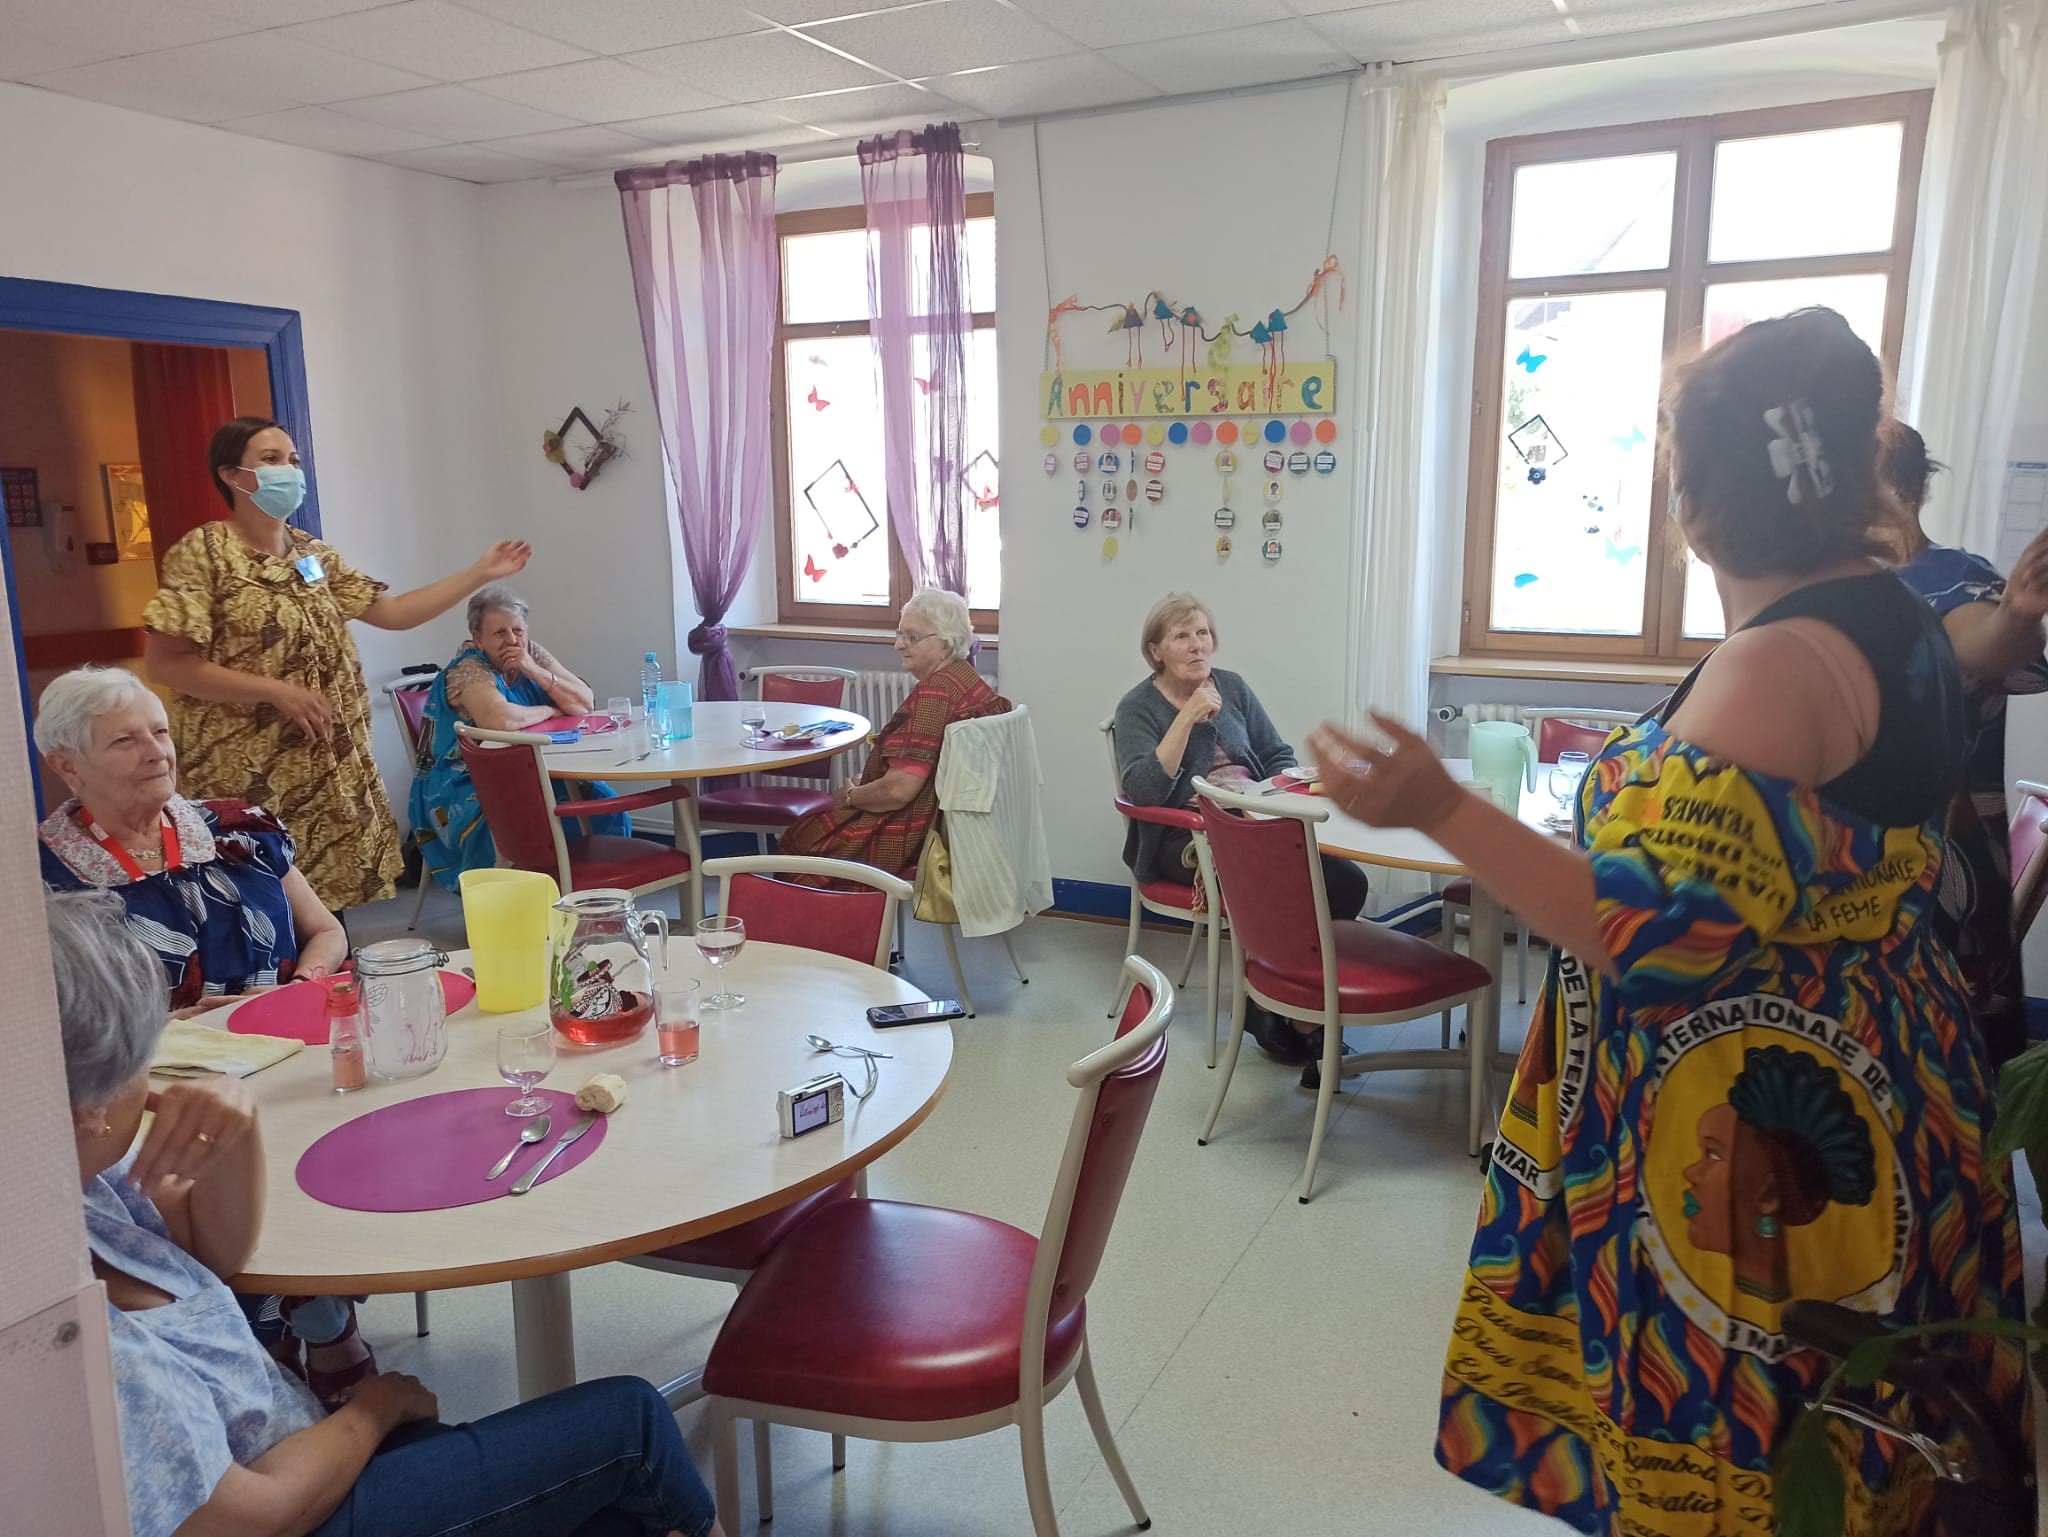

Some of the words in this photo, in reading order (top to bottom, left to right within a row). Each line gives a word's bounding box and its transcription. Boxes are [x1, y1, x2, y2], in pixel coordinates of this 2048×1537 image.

[1048, 373, 1323, 415] Anniversaire
[1807, 911, 1828, 932] LA
[1830, 895, 1881, 928] FEME
[1561, 956, 1585, 993] DE
[1567, 1001, 1589, 1039] LA
[1861, 1064, 1890, 1102] DE
[1494, 1142, 1539, 1186] MAR
[1748, 1328, 1789, 1358] MA
